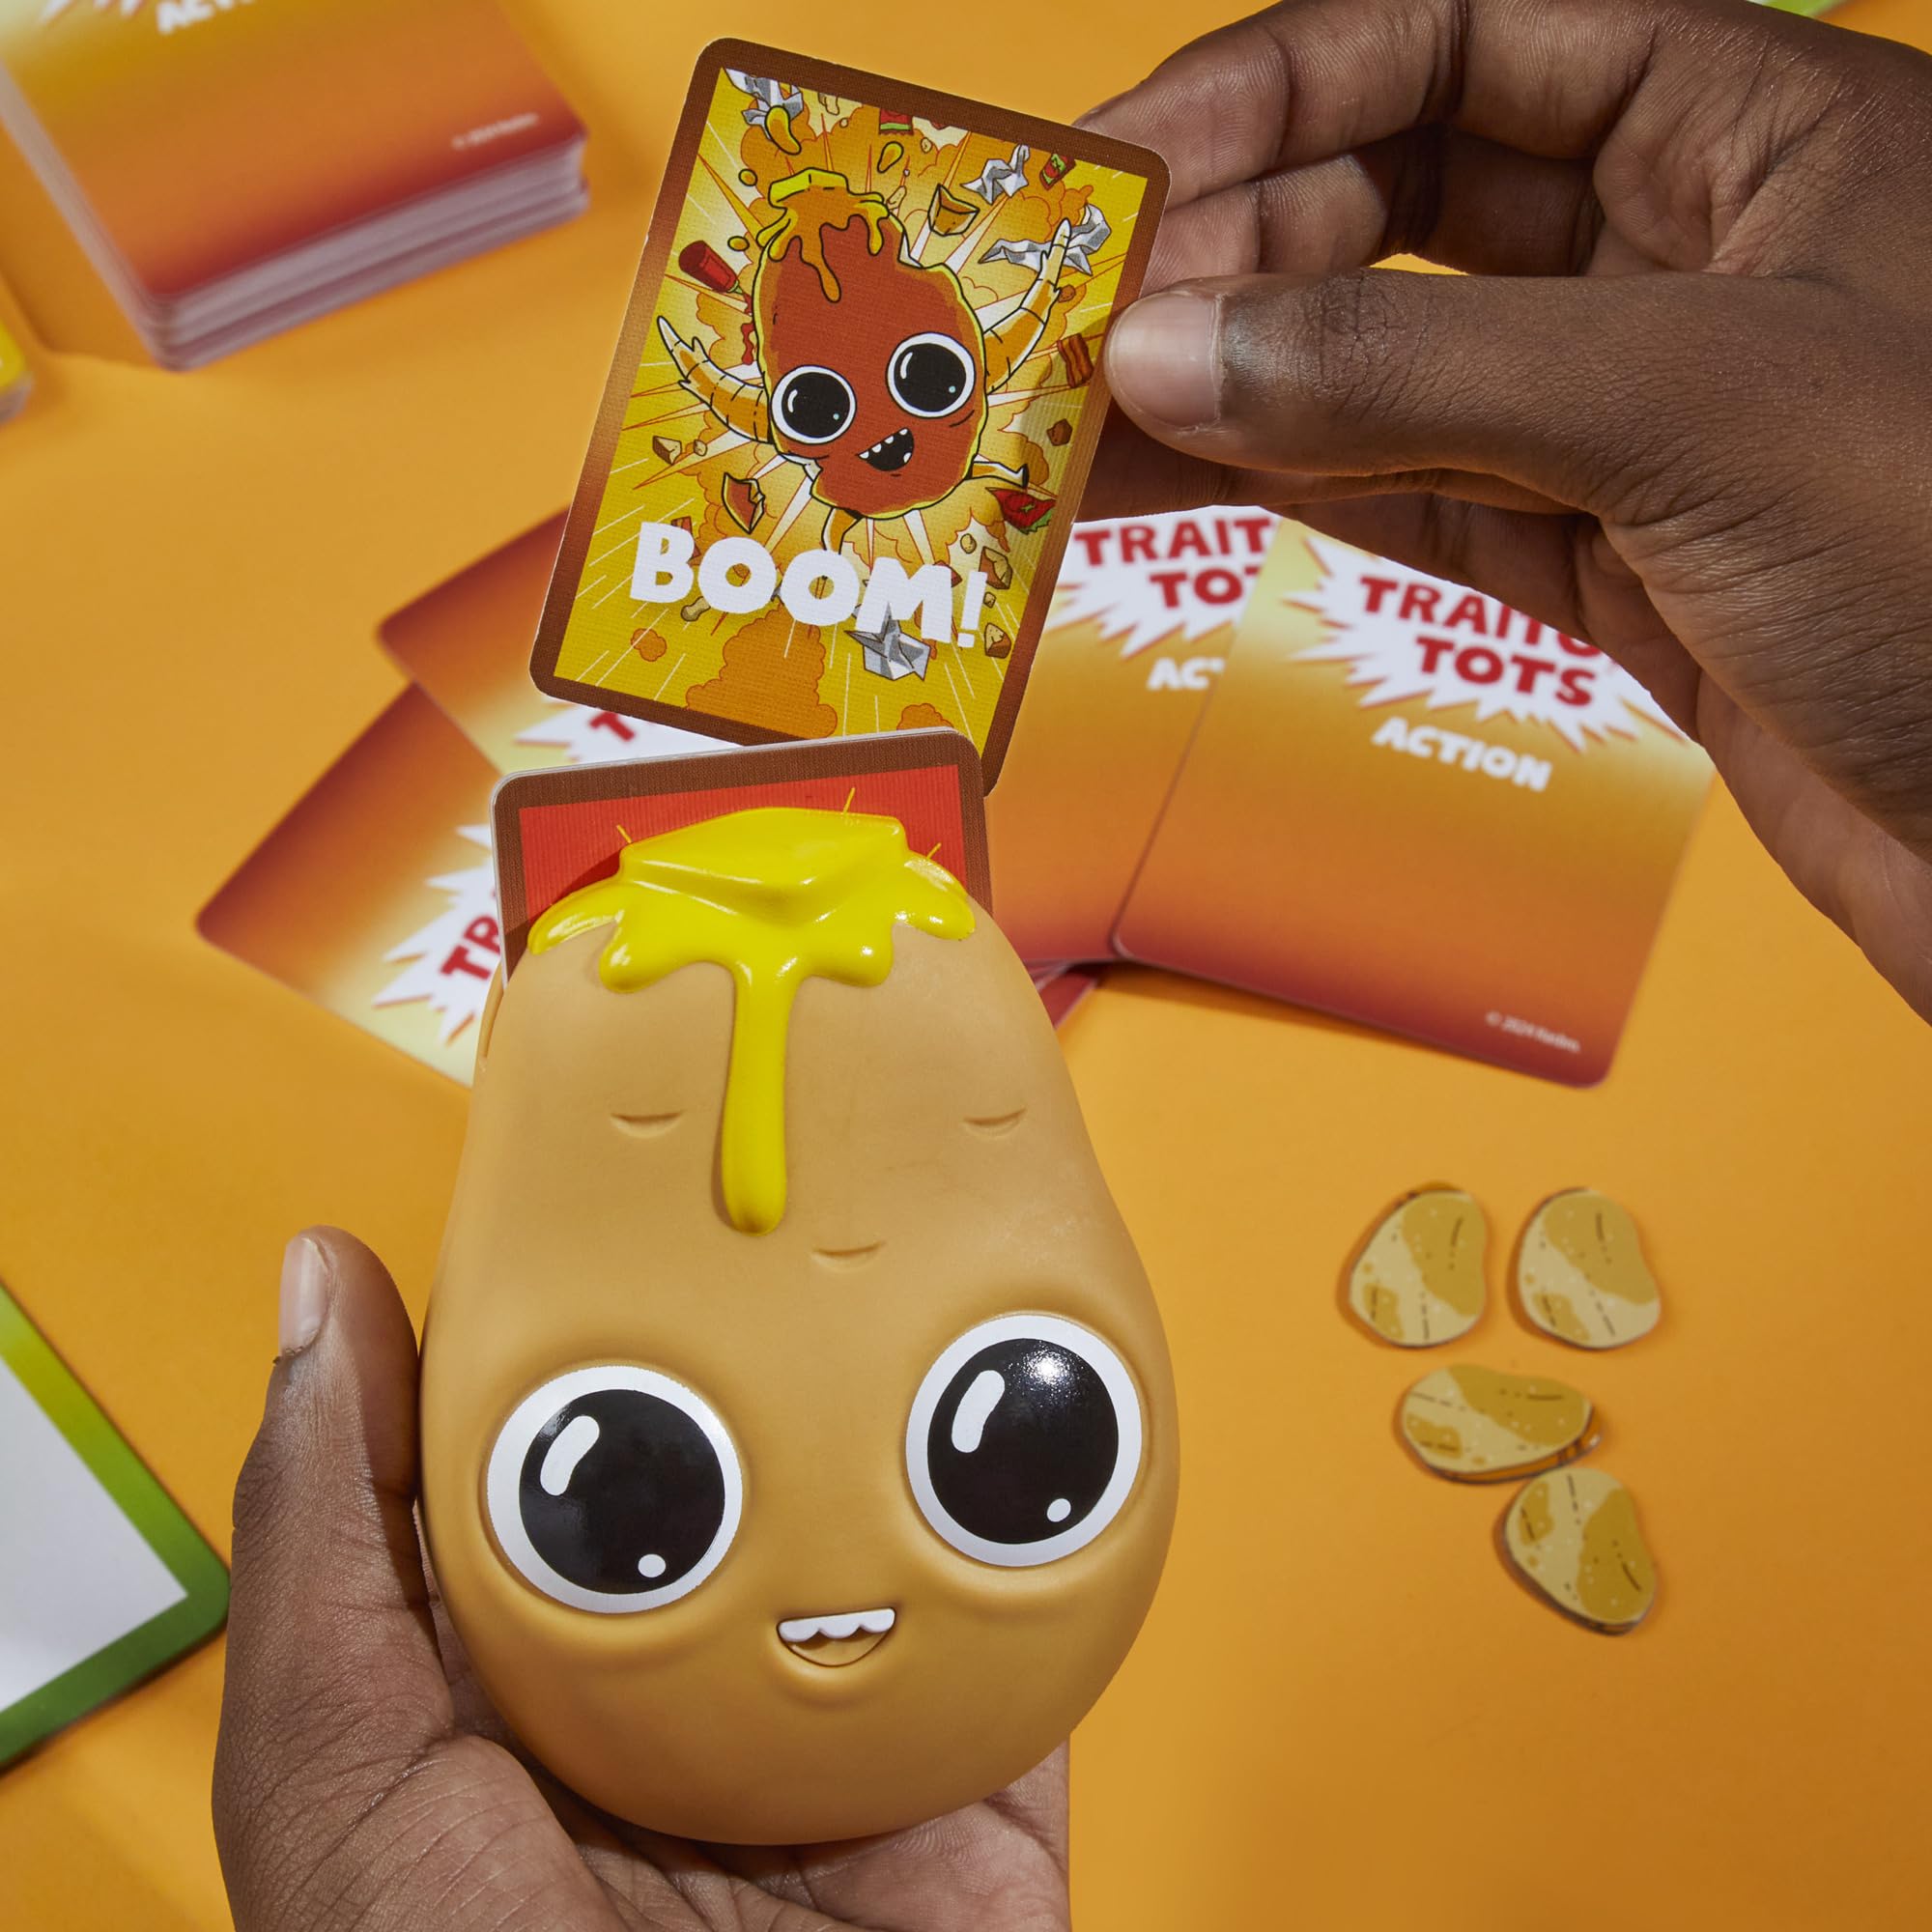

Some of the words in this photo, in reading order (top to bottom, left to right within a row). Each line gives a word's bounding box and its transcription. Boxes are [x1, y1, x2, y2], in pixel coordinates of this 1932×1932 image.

[1073, 518, 1271, 566] TRAIT
[630, 522, 987, 648] BOOM!
[1149, 566, 1261, 609] TO
[1360, 576, 1605, 659] TRAIT
[1416, 636, 1597, 707] TOTS
[1372, 717, 1552, 791] ACTION
[440, 891, 500, 980] TR
